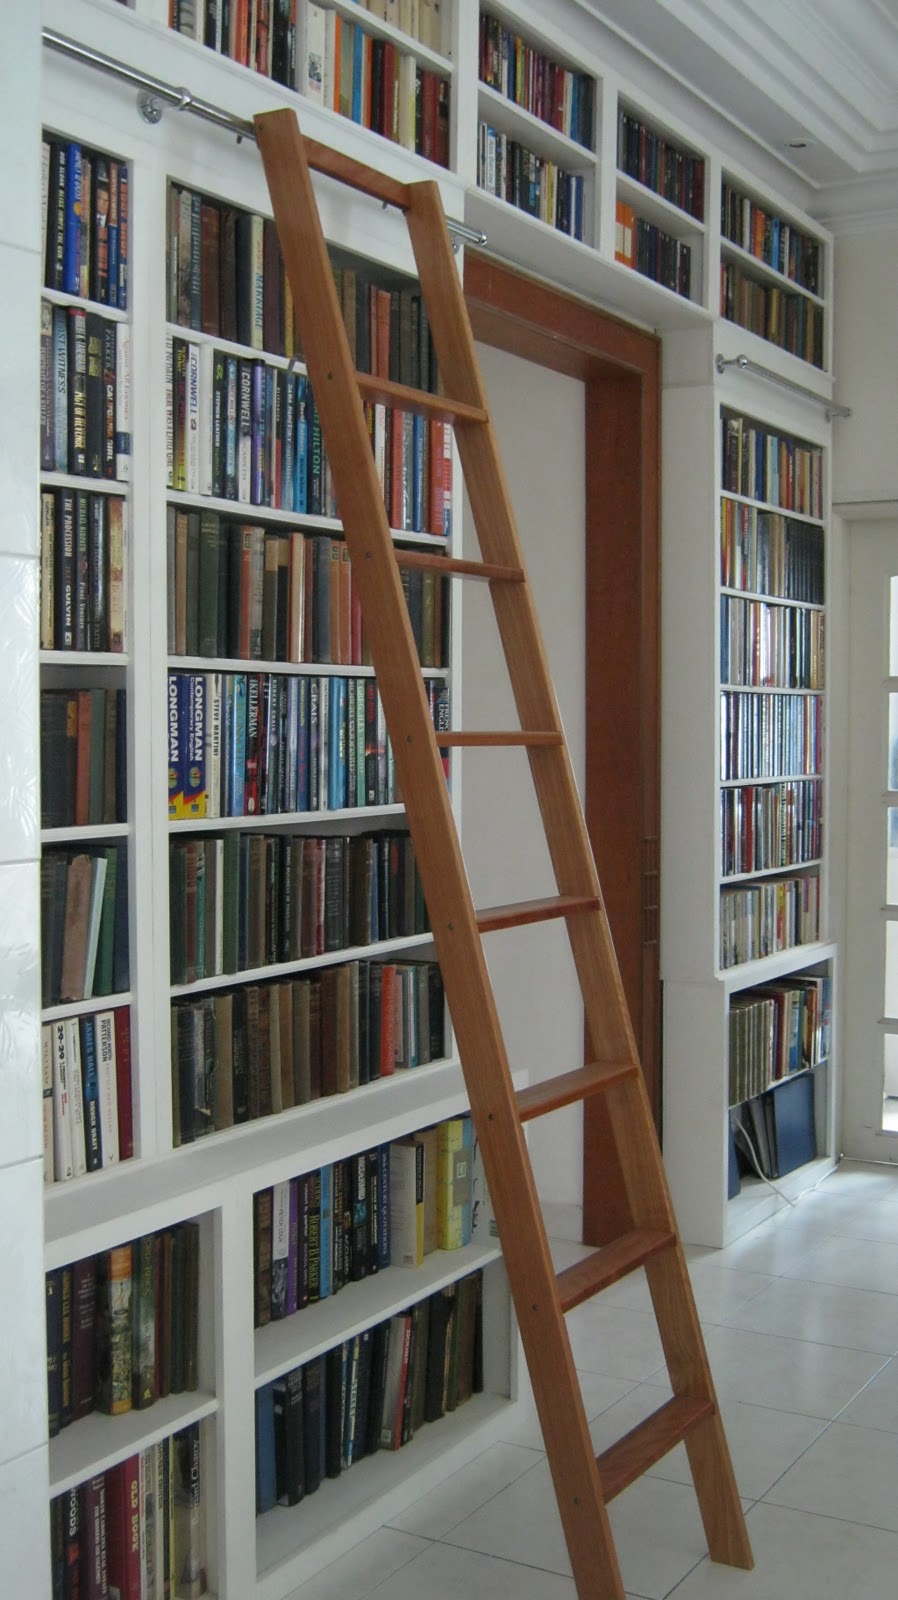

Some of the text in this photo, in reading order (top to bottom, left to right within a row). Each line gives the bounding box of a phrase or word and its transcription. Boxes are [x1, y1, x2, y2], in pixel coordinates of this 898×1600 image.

[57, 347, 66, 394] WITNESS
[190, 356, 198, 414] CORNWELL
[106, 384, 114, 461] CALIFORNIA GIRL
[240, 371, 251, 428] CORNWELL
[74, 417, 85, 449] REVENGE
[312, 426, 321, 475] HILTON
[64, 498, 73, 557] THE PROCESSION
[79, 497, 87, 553] MICHAEL RIDPATH
[169, 676, 179, 762] LONGMAN
[194, 676, 203, 761] LONGMAN
[248, 683, 258, 738] KELLERMAN
[357, 686, 365, 734] GREG ILES
[85, 1022, 95, 1079] JAMES HALL
[309, 1215, 320, 1247] ROBERT
[309, 1257, 320, 1288] PARKER
[69, 1486, 78, 1536] WOODS
[130, 1480, 139, 1552] OLD BOOK
